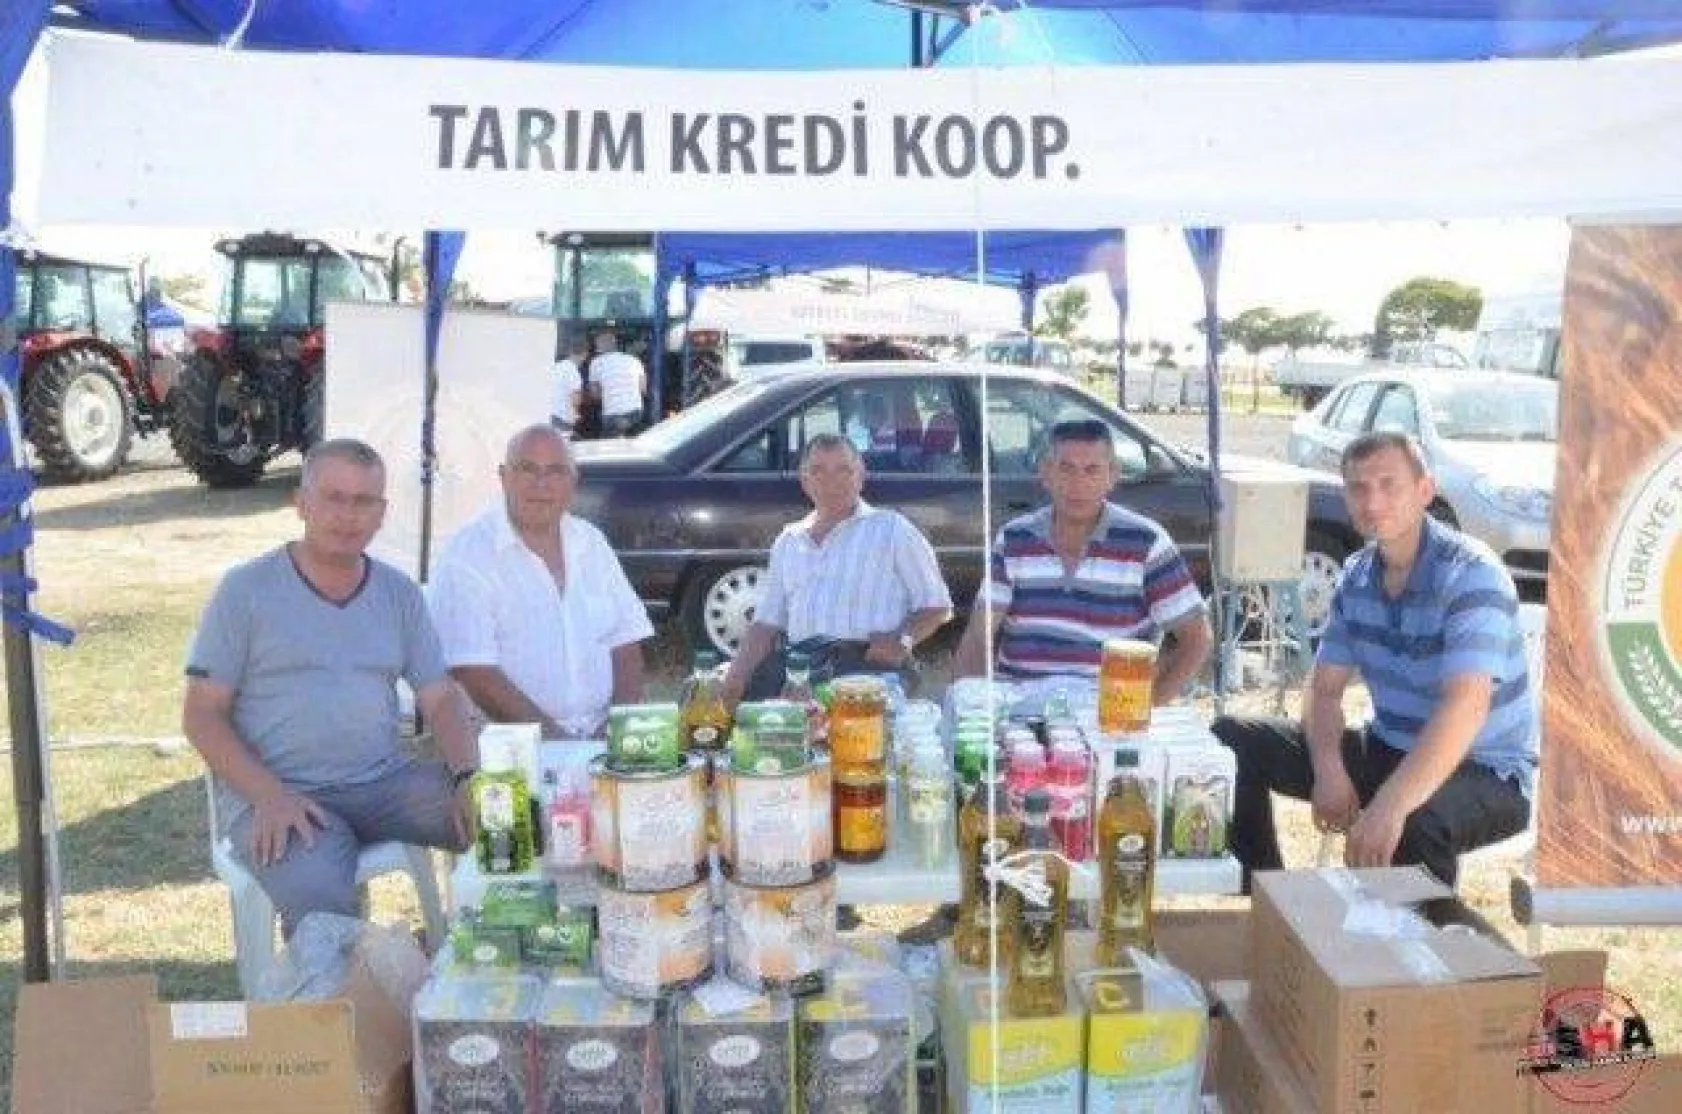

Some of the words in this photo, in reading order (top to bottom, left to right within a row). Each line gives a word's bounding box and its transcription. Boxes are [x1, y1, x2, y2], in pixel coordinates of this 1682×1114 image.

[429, 104, 645, 172] TARIM
[669, 99, 868, 176] KREDİ
[893, 114, 1081, 179] KOOP.
